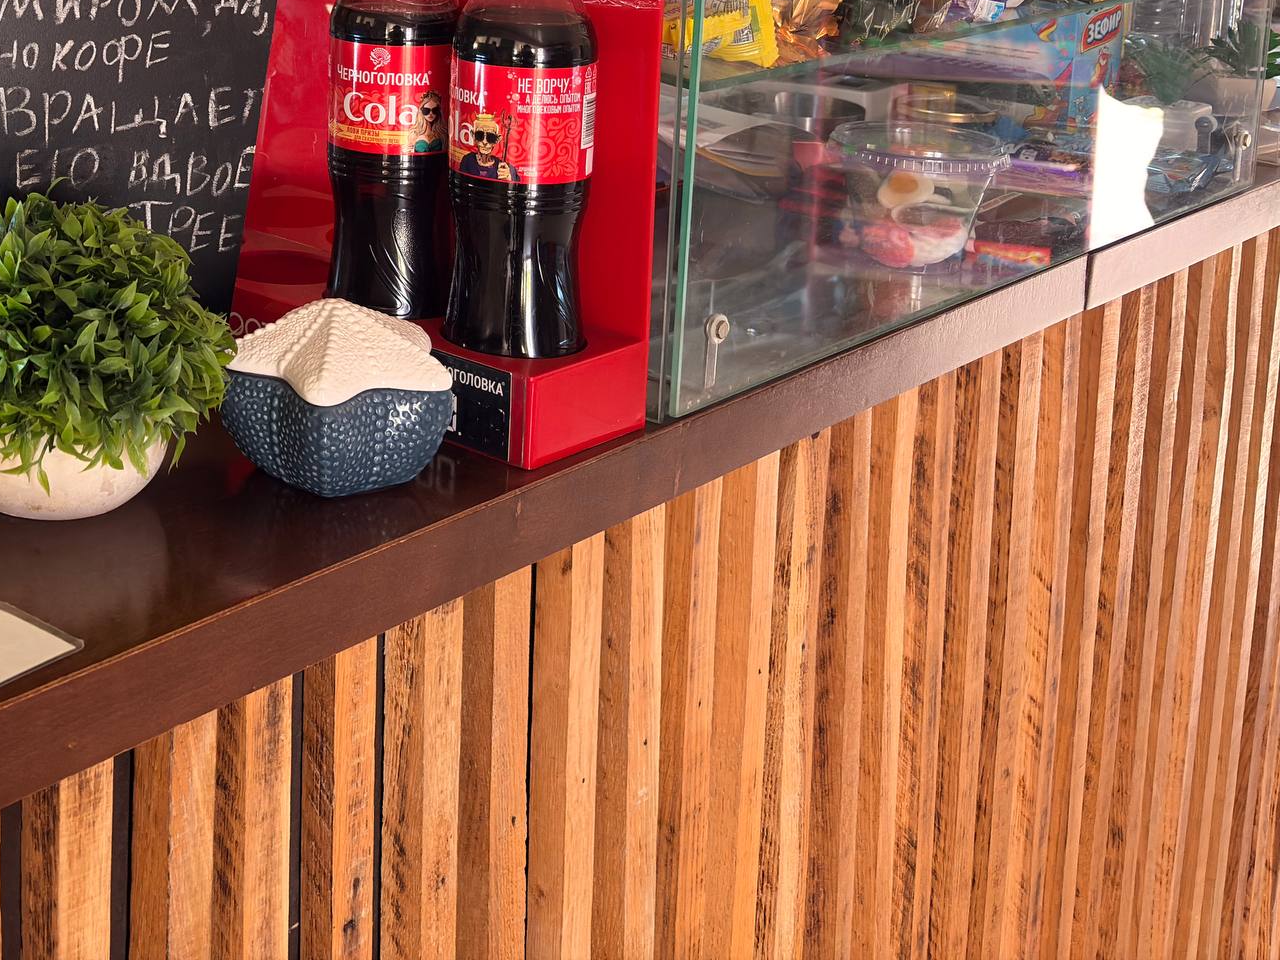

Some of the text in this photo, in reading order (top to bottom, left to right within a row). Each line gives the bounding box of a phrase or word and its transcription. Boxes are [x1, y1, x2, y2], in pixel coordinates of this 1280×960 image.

[1086, 10, 1122, 45] ЗЕФИР
[51, 30, 171, 82] КОФЕ
[337, 64, 430, 86] ЧЕРНОГОЛОВКА
[517, 77, 571, 94] НЕ ВОРЧУ,
[0, 86, 266, 148] ВРАЩАЕТ
[343, 91, 418, 126] Cola
[360, 127, 380, 137] ПРИЗЫ
[128, 144, 256, 198] ВДВОЕ
[128, 200, 244, 254] ТРЕЕ
[445, 364, 505, 397] ОГОЛОВКА
